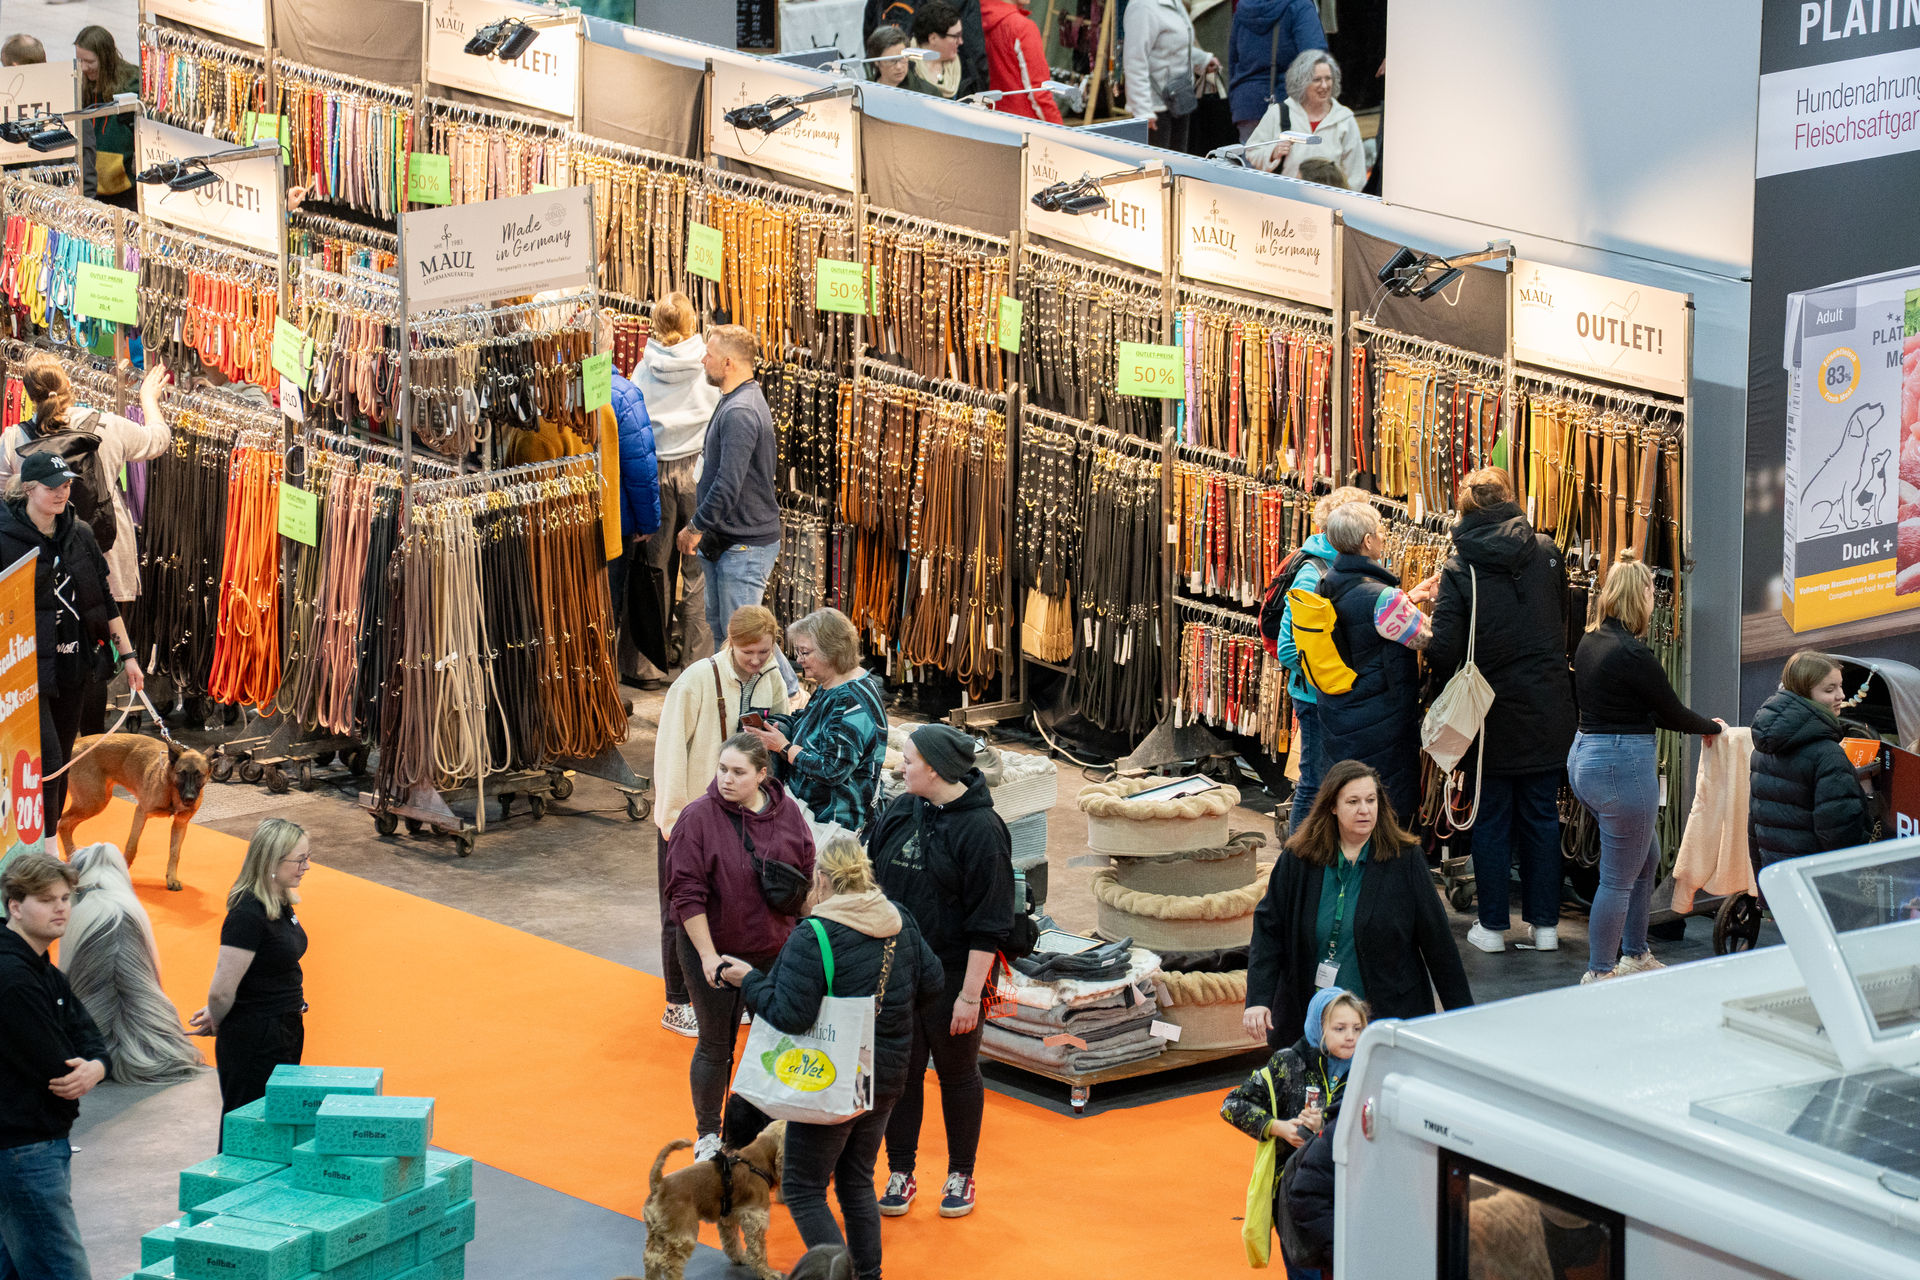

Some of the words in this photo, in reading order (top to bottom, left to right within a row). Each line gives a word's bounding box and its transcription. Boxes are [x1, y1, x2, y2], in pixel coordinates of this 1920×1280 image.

[792, 122, 841, 149] Germany
[502, 213, 542, 244] Made
[1191, 225, 1238, 252] MAUL
[1261, 219, 1295, 239] Made
[495, 248, 510, 261] in
[512, 228, 572, 257] Germany
[694, 244, 714, 267] 50%
[1255, 242, 1267, 254] in
[1269, 239, 1321, 266] Germany
[419, 251, 475, 278] MAUL
[423, 270, 475, 287] LEDERMANUFAKTUR
[829, 281, 864, 301] 50%
[1519, 288, 1554, 309] MAUL
[1815, 308, 1844, 326] Adult
[1576, 311, 1663, 355] OUTLET!
[1133, 365, 1175, 385] 50%
[1826, 364, 1852, 387] 83%
[1842, 538, 1880, 561] Duck
[0, 633, 35, 678] aktion
[23, 762, 40, 790] Nur
[1423, 1119, 1448, 1137] THULE
